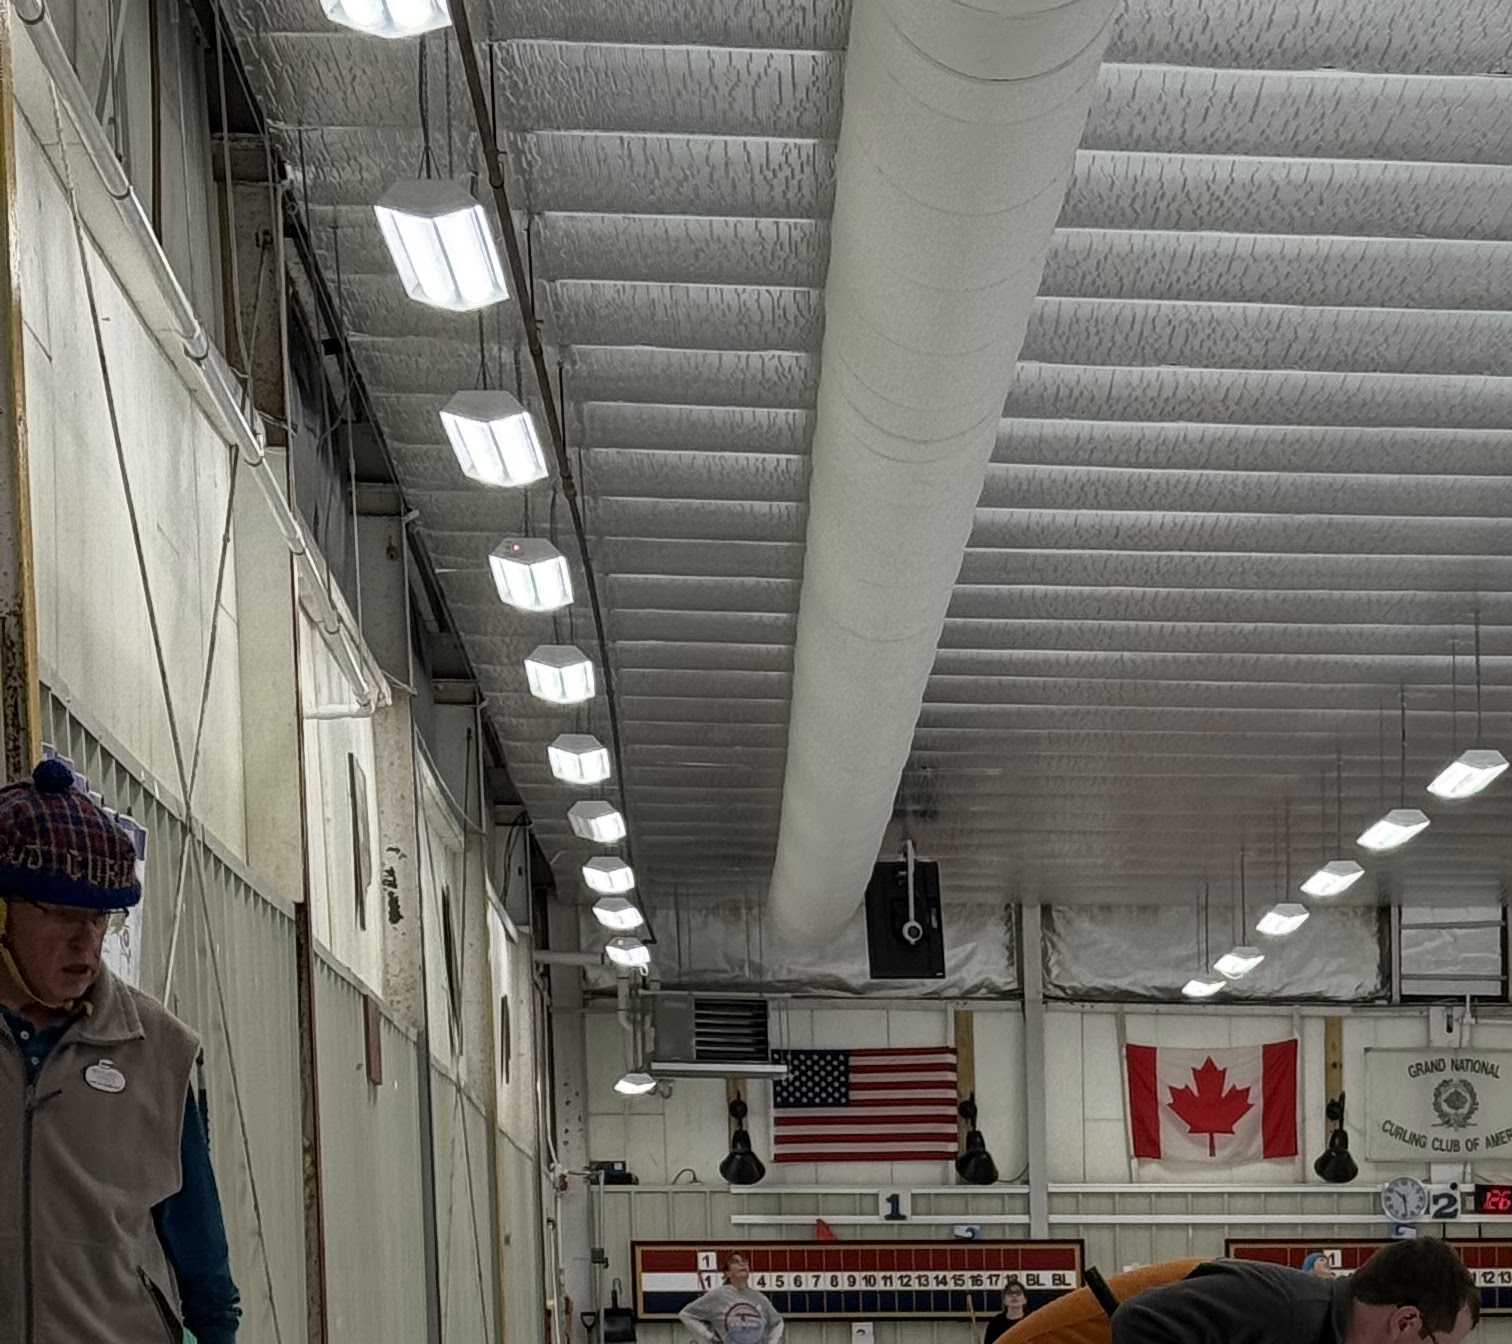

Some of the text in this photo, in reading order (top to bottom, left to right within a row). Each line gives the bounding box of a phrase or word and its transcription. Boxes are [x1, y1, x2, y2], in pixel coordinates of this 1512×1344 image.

[1407, 1058, 1500, 1079] GRAND NATIONAL
[1381, 1119, 1428, 1149] CURLING
[1431, 1137, 1461, 1153] CLUB
[1464, 1137, 1480, 1152] OF
[884, 1193, 908, 1221] 1
[1431, 1192, 1459, 1219] 2
[701, 1255, 710, 1268] 1
[756, 1275, 766, 1288] 4
[775, 1275, 785, 1288] 5
[793, 1275, 803, 1288] 6
[811, 1275, 821, 1288] 7
[830, 1275, 839, 1288] 8
[847, 1275, 857, 1288] 9
[862, 1274, 876, 1287] 10
[881, 1274, 893, 1287] 11
[897, 1274, 912, 1287] 12
[915, 1274, 929, 1287] 13
[933, 1274, 948, 1287] 14
[950, 1274, 965, 1287] 15
[968, 1274, 983, 1287] 16
[986, 1273, 1001, 1286] 17
[1026, 1273, 1046, 1287] BL
[1051, 1273, 1072, 1287] BL
[1481, 1271, 1495, 1284] 12
[1498, 1271, 1512, 1284] 13
